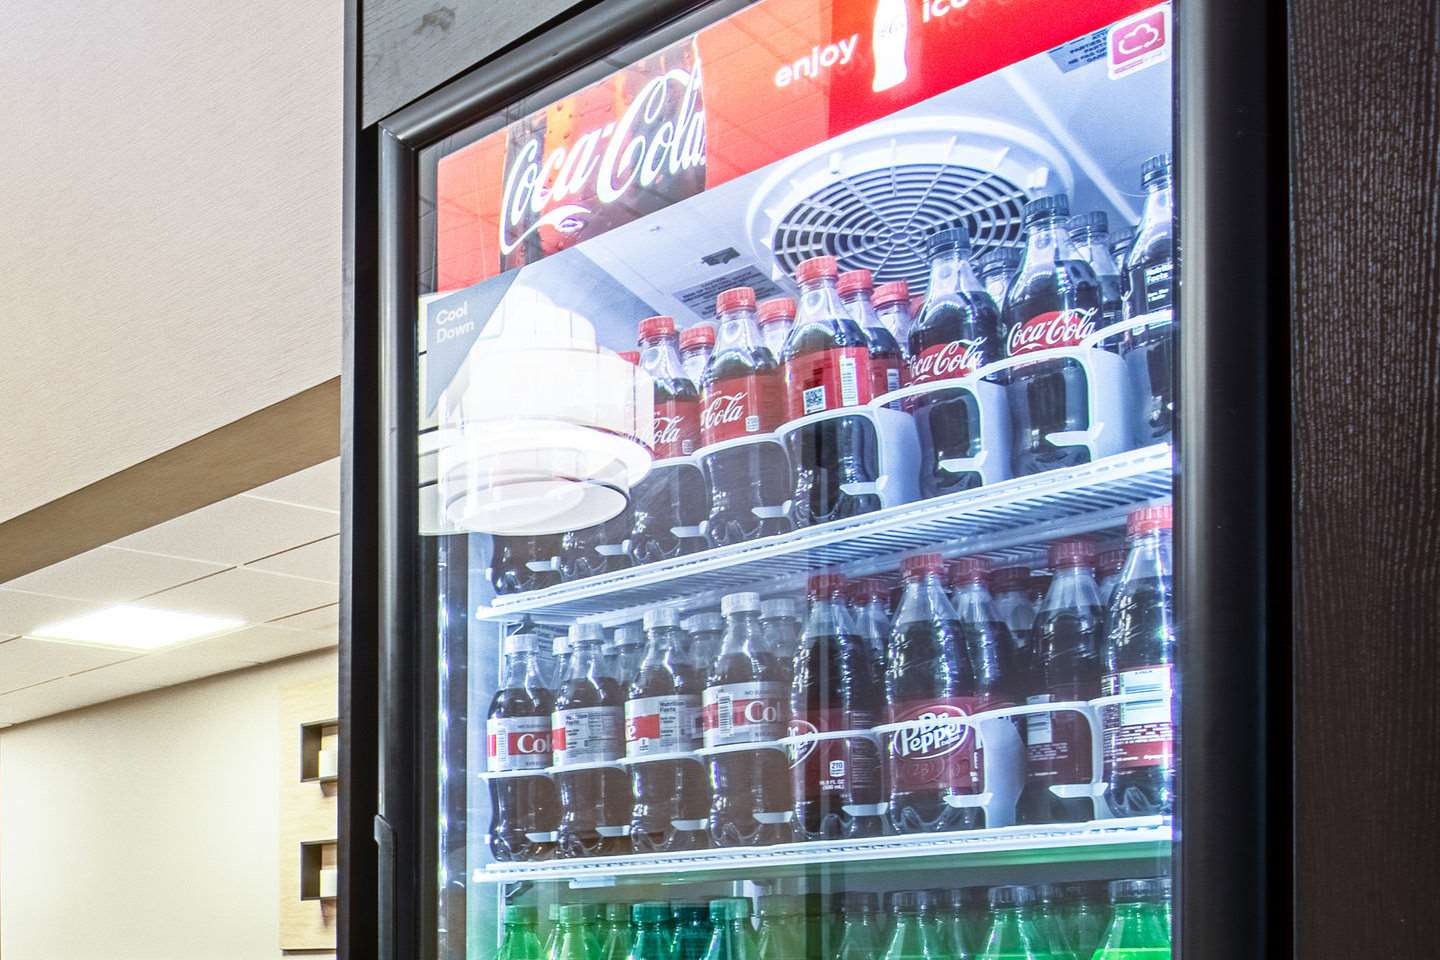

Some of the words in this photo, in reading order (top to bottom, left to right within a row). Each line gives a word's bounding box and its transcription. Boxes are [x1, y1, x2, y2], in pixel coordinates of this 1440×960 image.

[774, 33, 859, 88] enjoy
[499, 62, 707, 255] Coca-Cola
[436, 300, 468, 325] Cool
[437, 321, 475, 344] Down
[1007, 307, 1098, 357] Coca-Cola
[901, 722, 964, 757] Pepper
